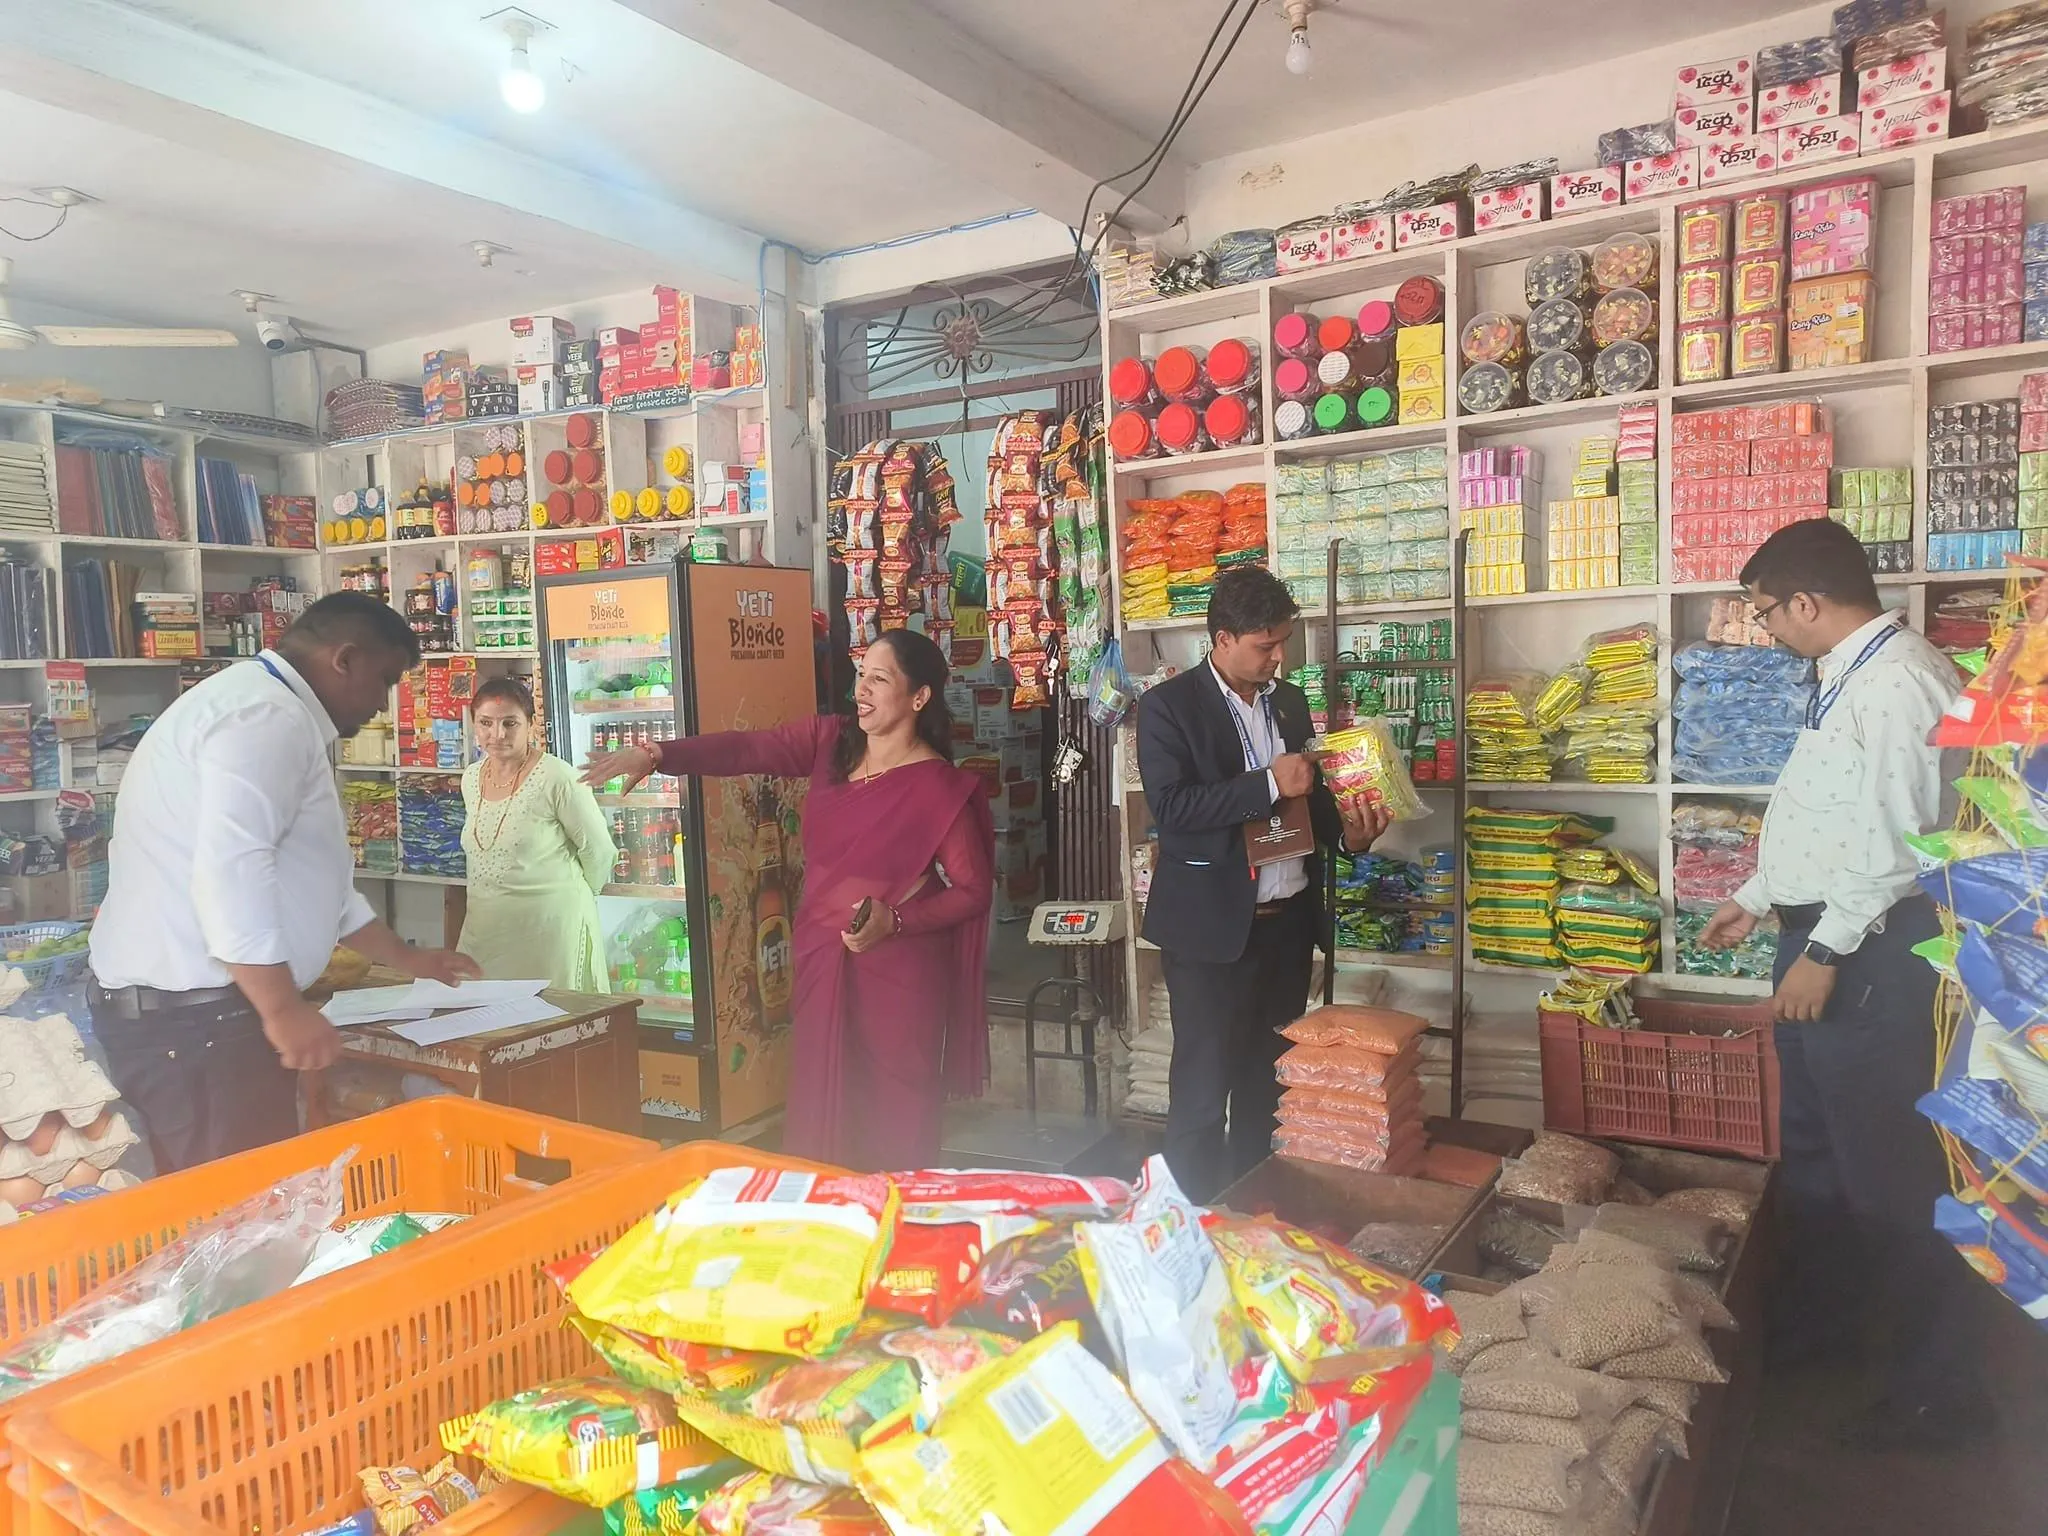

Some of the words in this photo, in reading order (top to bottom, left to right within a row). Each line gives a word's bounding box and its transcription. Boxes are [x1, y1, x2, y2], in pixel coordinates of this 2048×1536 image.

[1798, 125, 1839, 150] फ्रेश
[1719, 142, 1757, 167] फ्रेश
[1568, 176, 1603, 199] फ्रेश
[1410, 212, 1440, 234] फ्रेश
[1793, 227, 1815, 242] Long
[1813, 221, 1836, 235] Ride
[1790, 318, 1811, 331] Long
[1811, 313, 1832, 327] Ride
[590, 604, 625, 621] Blonde
[728, 617, 785, 649] Blonde
